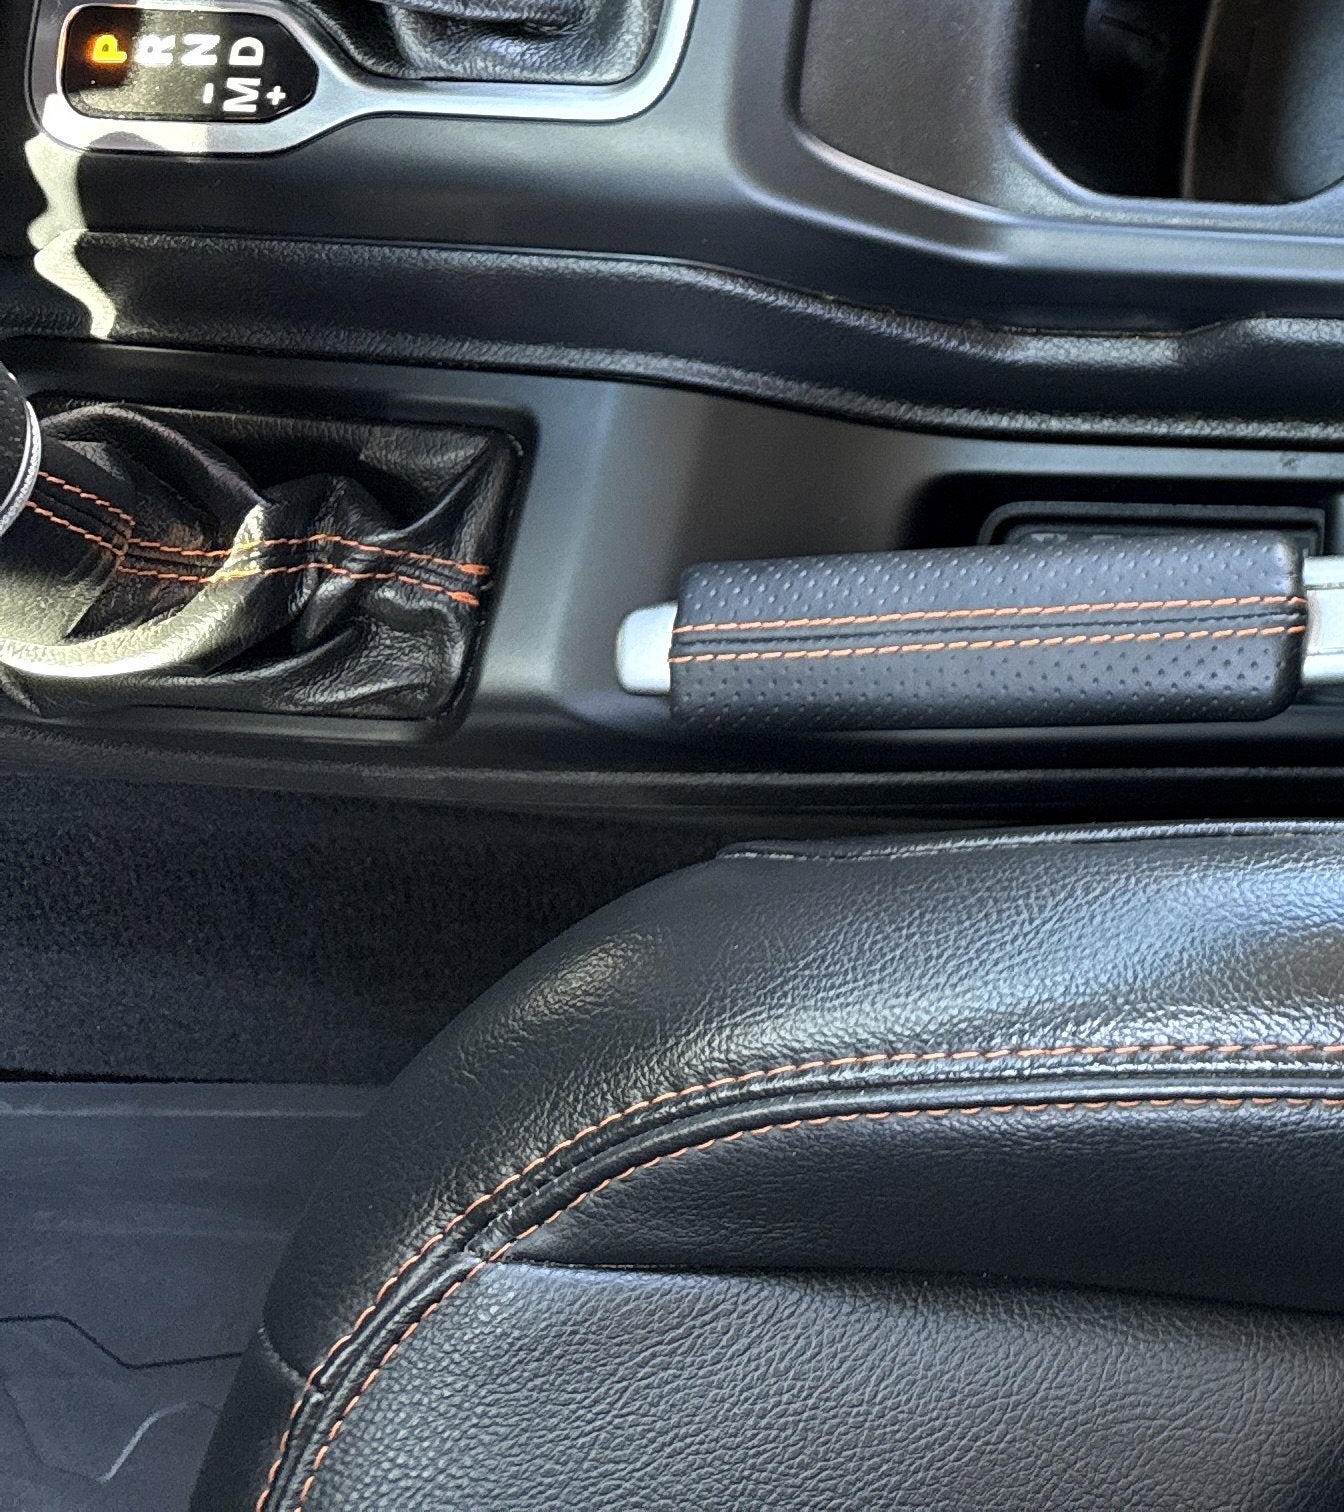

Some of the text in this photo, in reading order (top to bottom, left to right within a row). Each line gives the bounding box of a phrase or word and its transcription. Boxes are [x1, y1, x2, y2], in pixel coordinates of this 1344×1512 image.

[93, 34, 127, 63] P
[136, 35, 176, 66] R
[181, 34, 221, 66] N
[223, 36, 264, 113] M D
